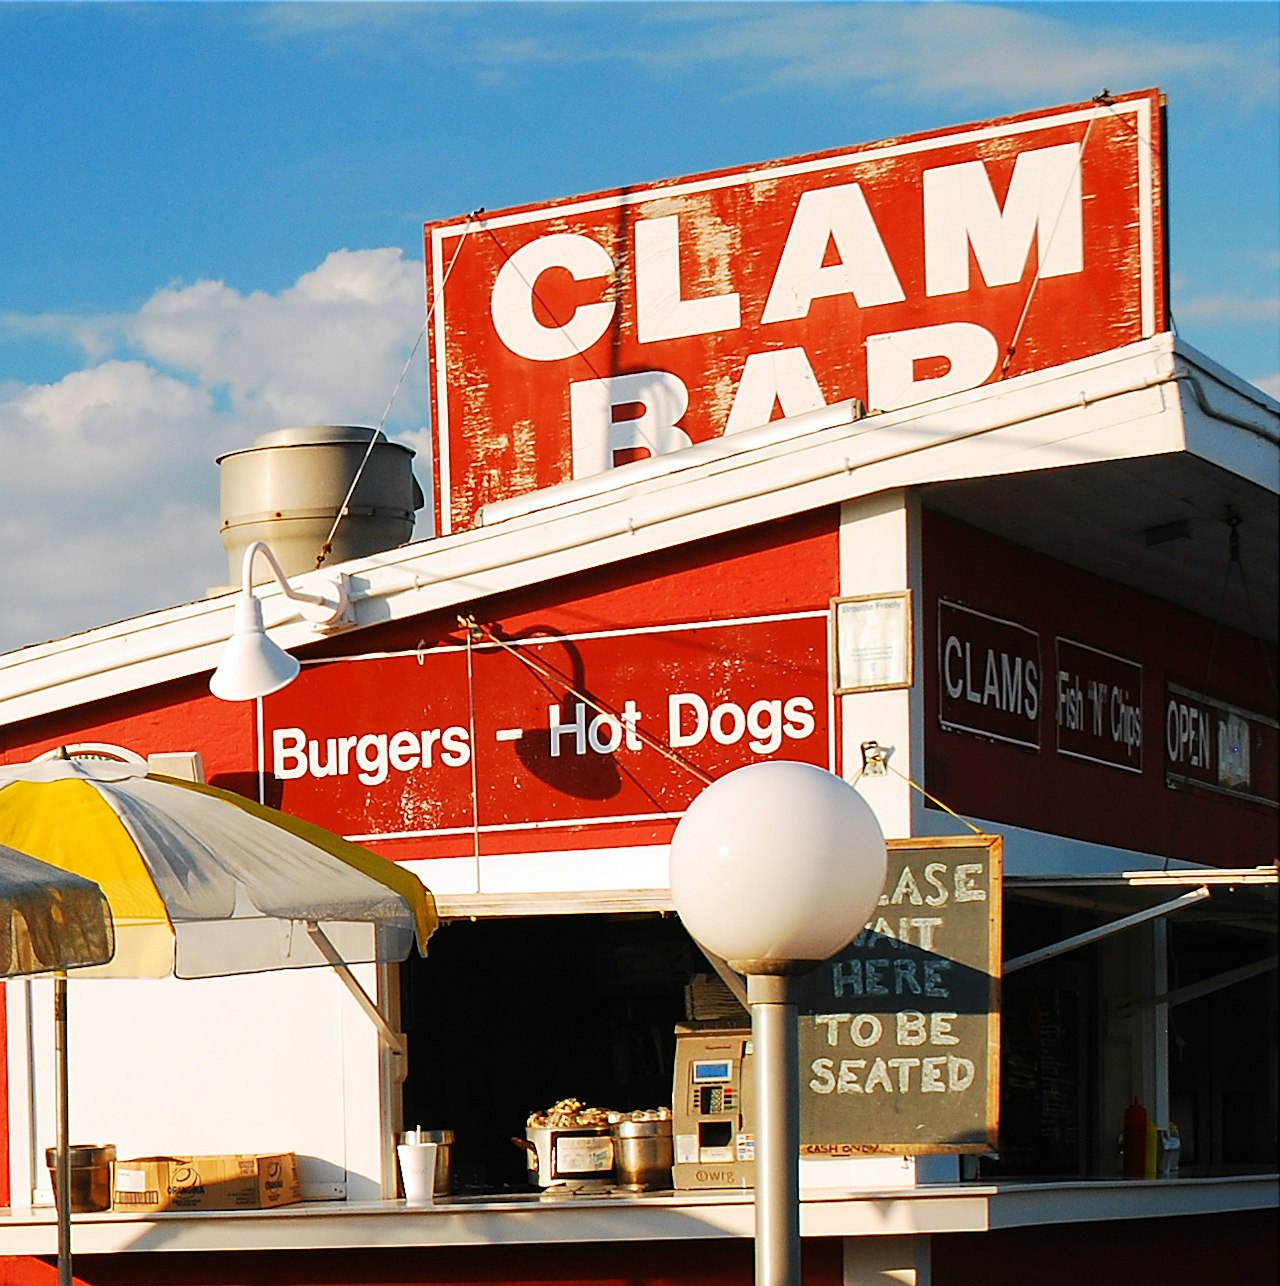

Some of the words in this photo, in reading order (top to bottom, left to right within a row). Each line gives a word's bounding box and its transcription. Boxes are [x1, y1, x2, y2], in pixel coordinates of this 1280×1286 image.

[491, 142, 1083, 361] CLAM
[945, 636, 1038, 720] CLAMS
[272, 727, 471, 786] Burgers
[549, 701, 642, 757] Hot
[669, 693, 816, 754] Dogs
[1058, 670, 1083, 731] Fish
[1111, 686, 1140, 756] Chips
[1167, 700, 1209, 769] OPEN
[877, 863, 986, 906] ASE
[832, 958, 951, 998] HERE
[815, 1013, 883, 1047] TO
[896, 1011, 960, 1046] BE
[809, 1056, 976, 1094] SEATED
